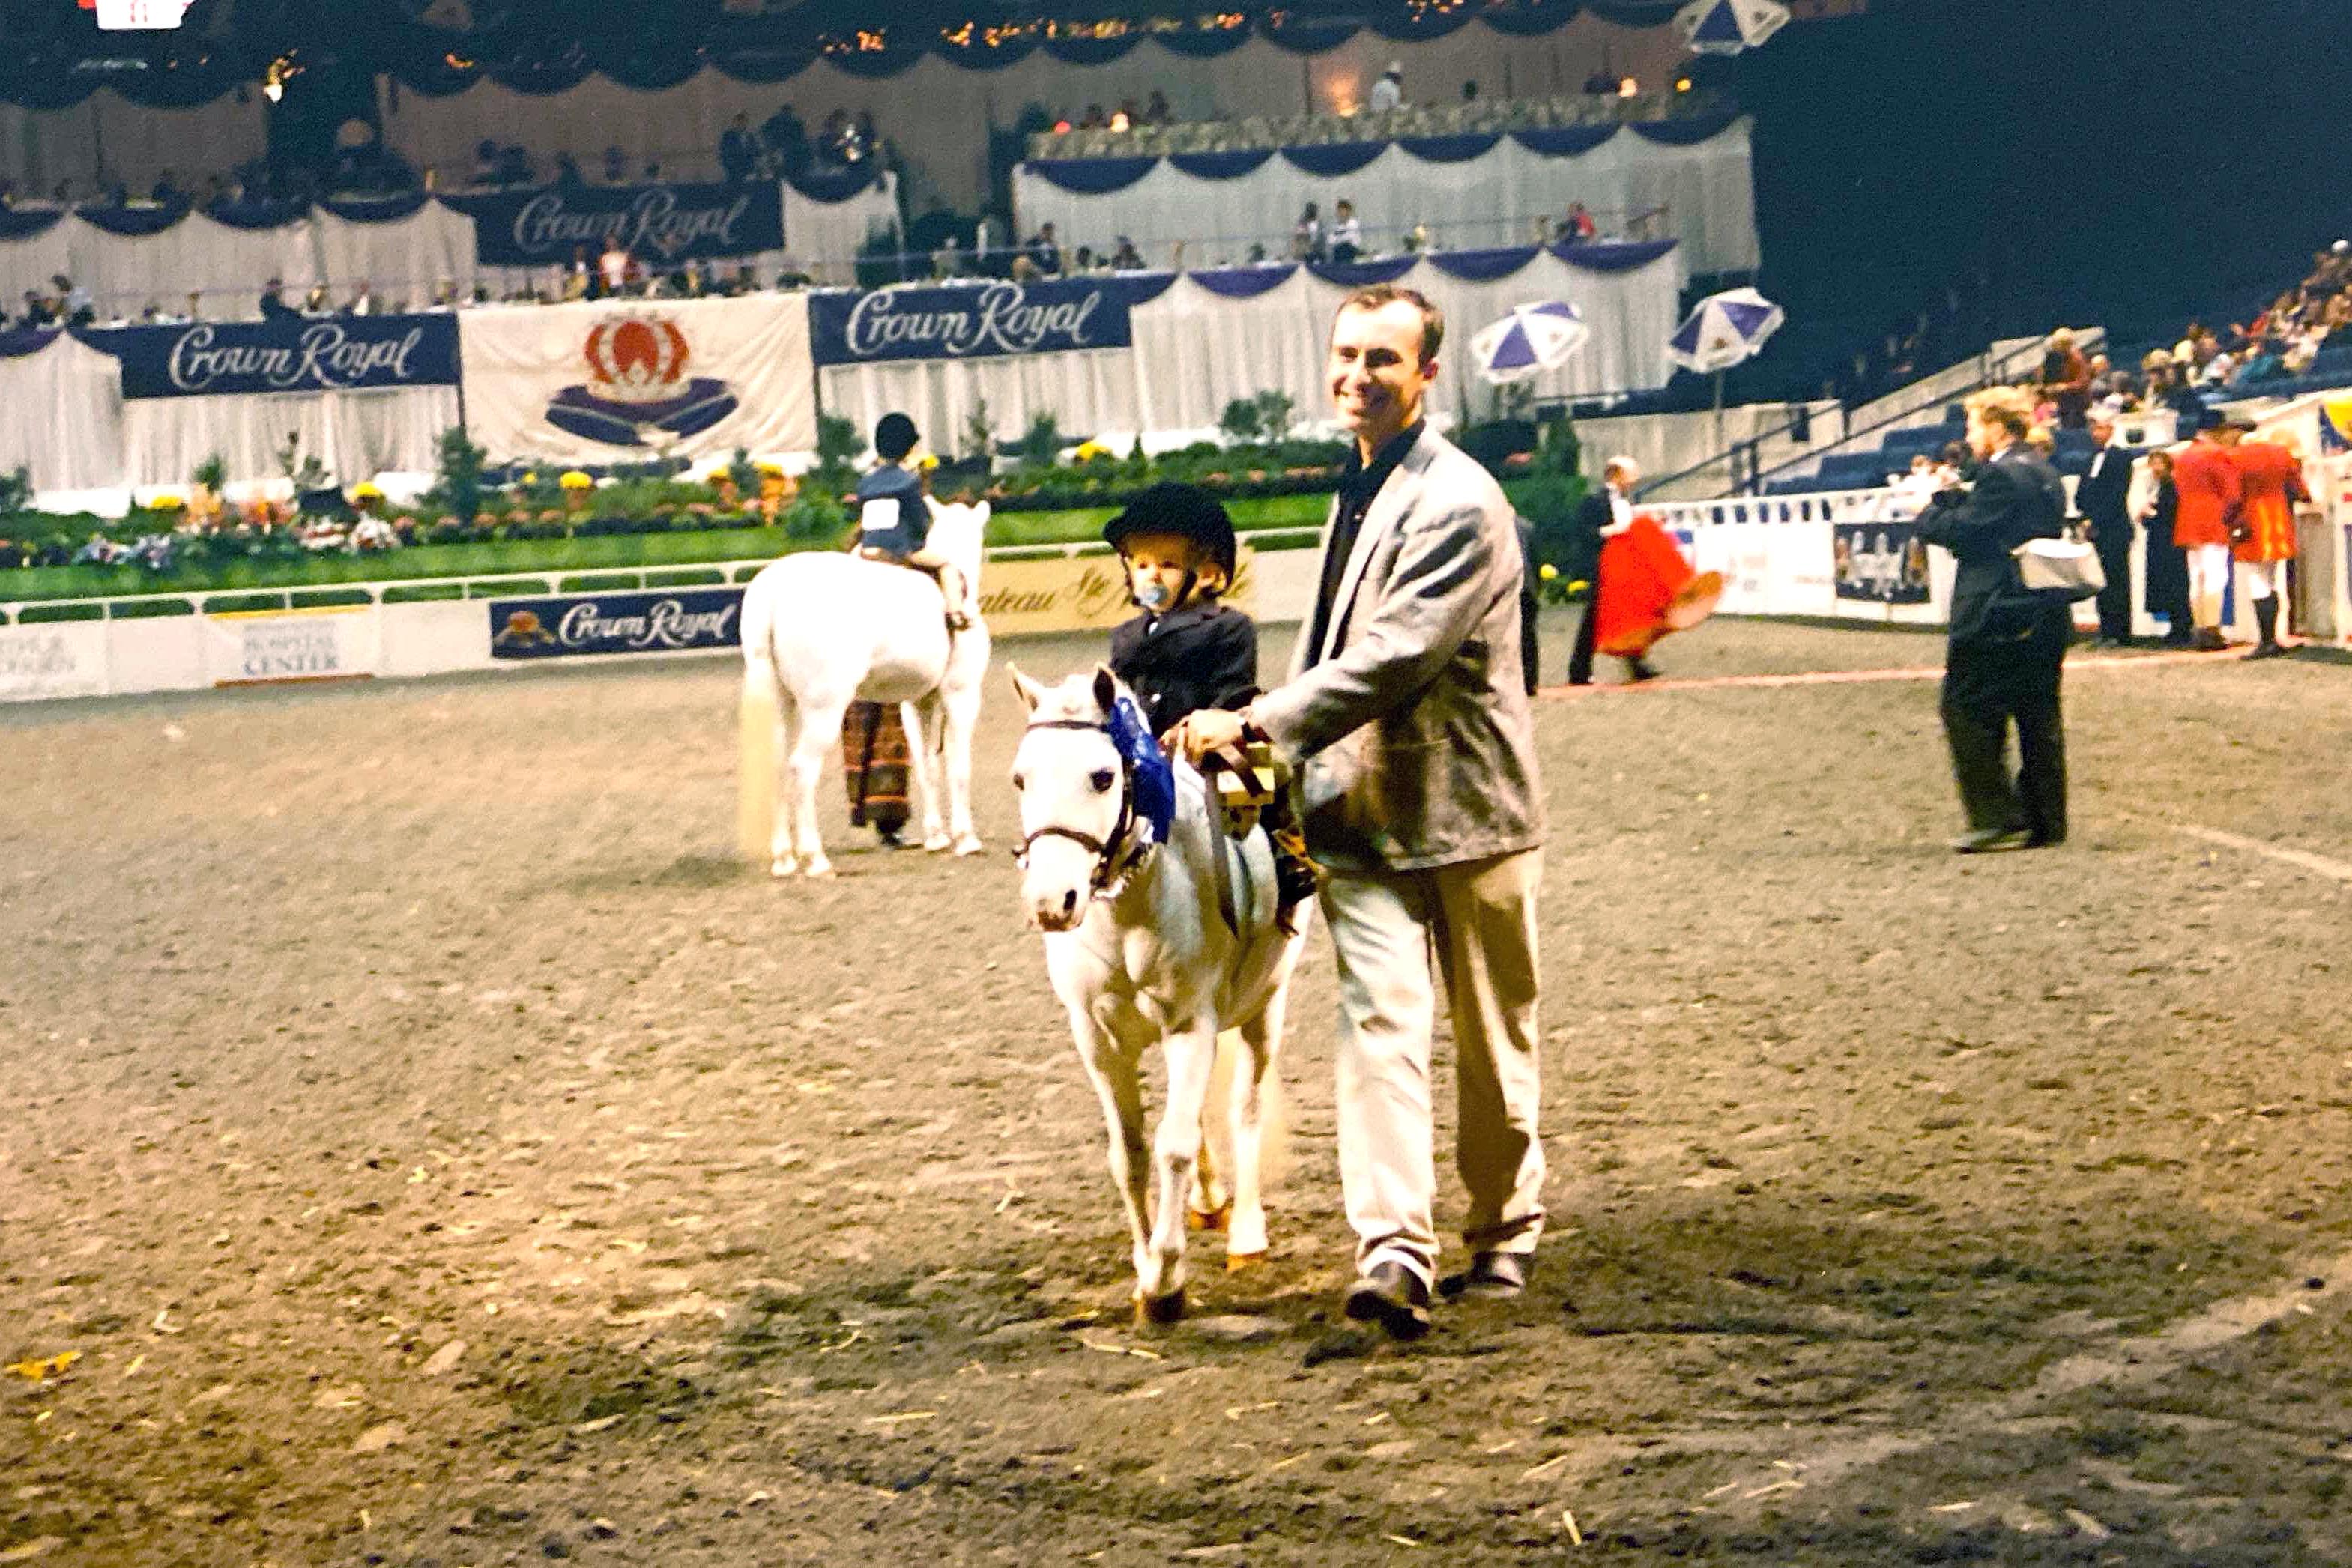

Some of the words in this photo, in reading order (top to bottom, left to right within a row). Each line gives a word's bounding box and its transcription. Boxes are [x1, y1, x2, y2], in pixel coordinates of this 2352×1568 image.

[511, 193, 628, 253] Crown
[628, 189, 748, 257] Royal
[846, 284, 967, 354] Crown
[947, 279, 1101, 352] Royal
[169, 324, 291, 390] Crown
[268, 324, 423, 388] Royal
[560, 603, 645, 646] Crown
[628, 600, 737, 647] Royal
[244, 653, 339, 675] CENTER
